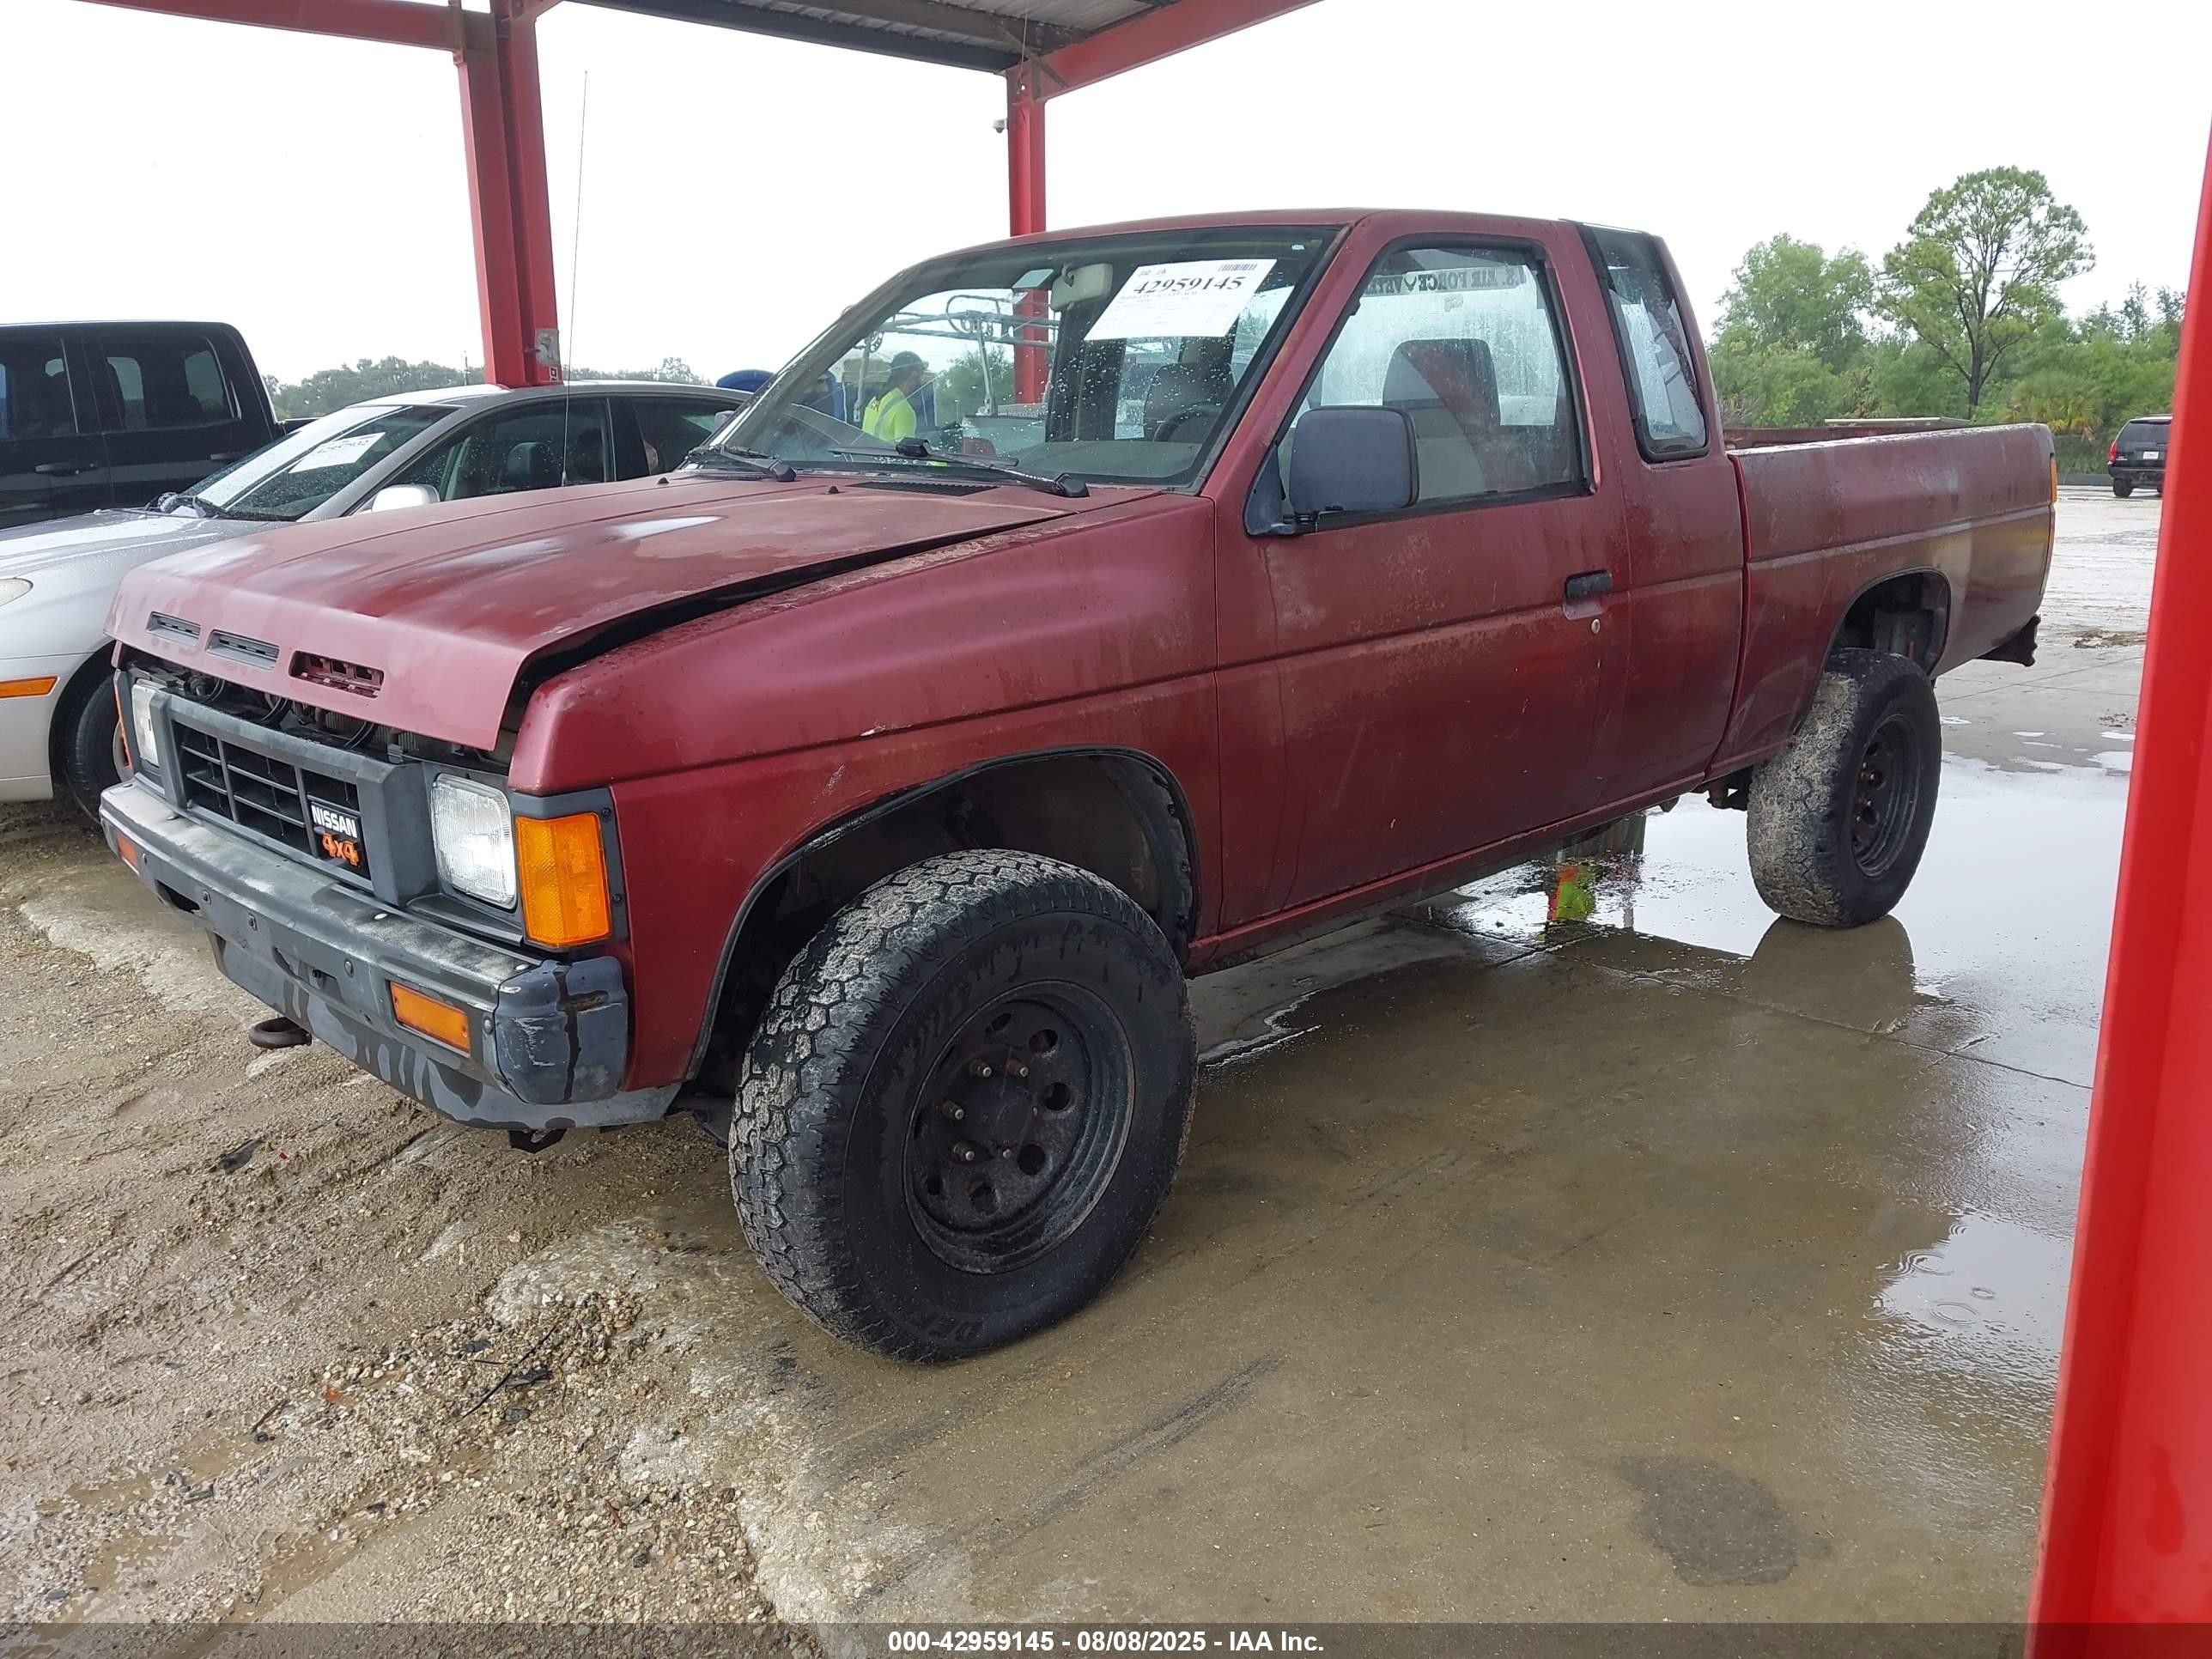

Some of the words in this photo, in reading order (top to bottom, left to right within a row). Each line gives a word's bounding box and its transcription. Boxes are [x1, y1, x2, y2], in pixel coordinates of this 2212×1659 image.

[1133, 276, 1247, 295] 42959145
[311, 805, 358, 838] NISSAN
[322, 833, 359, 866] 4x4
